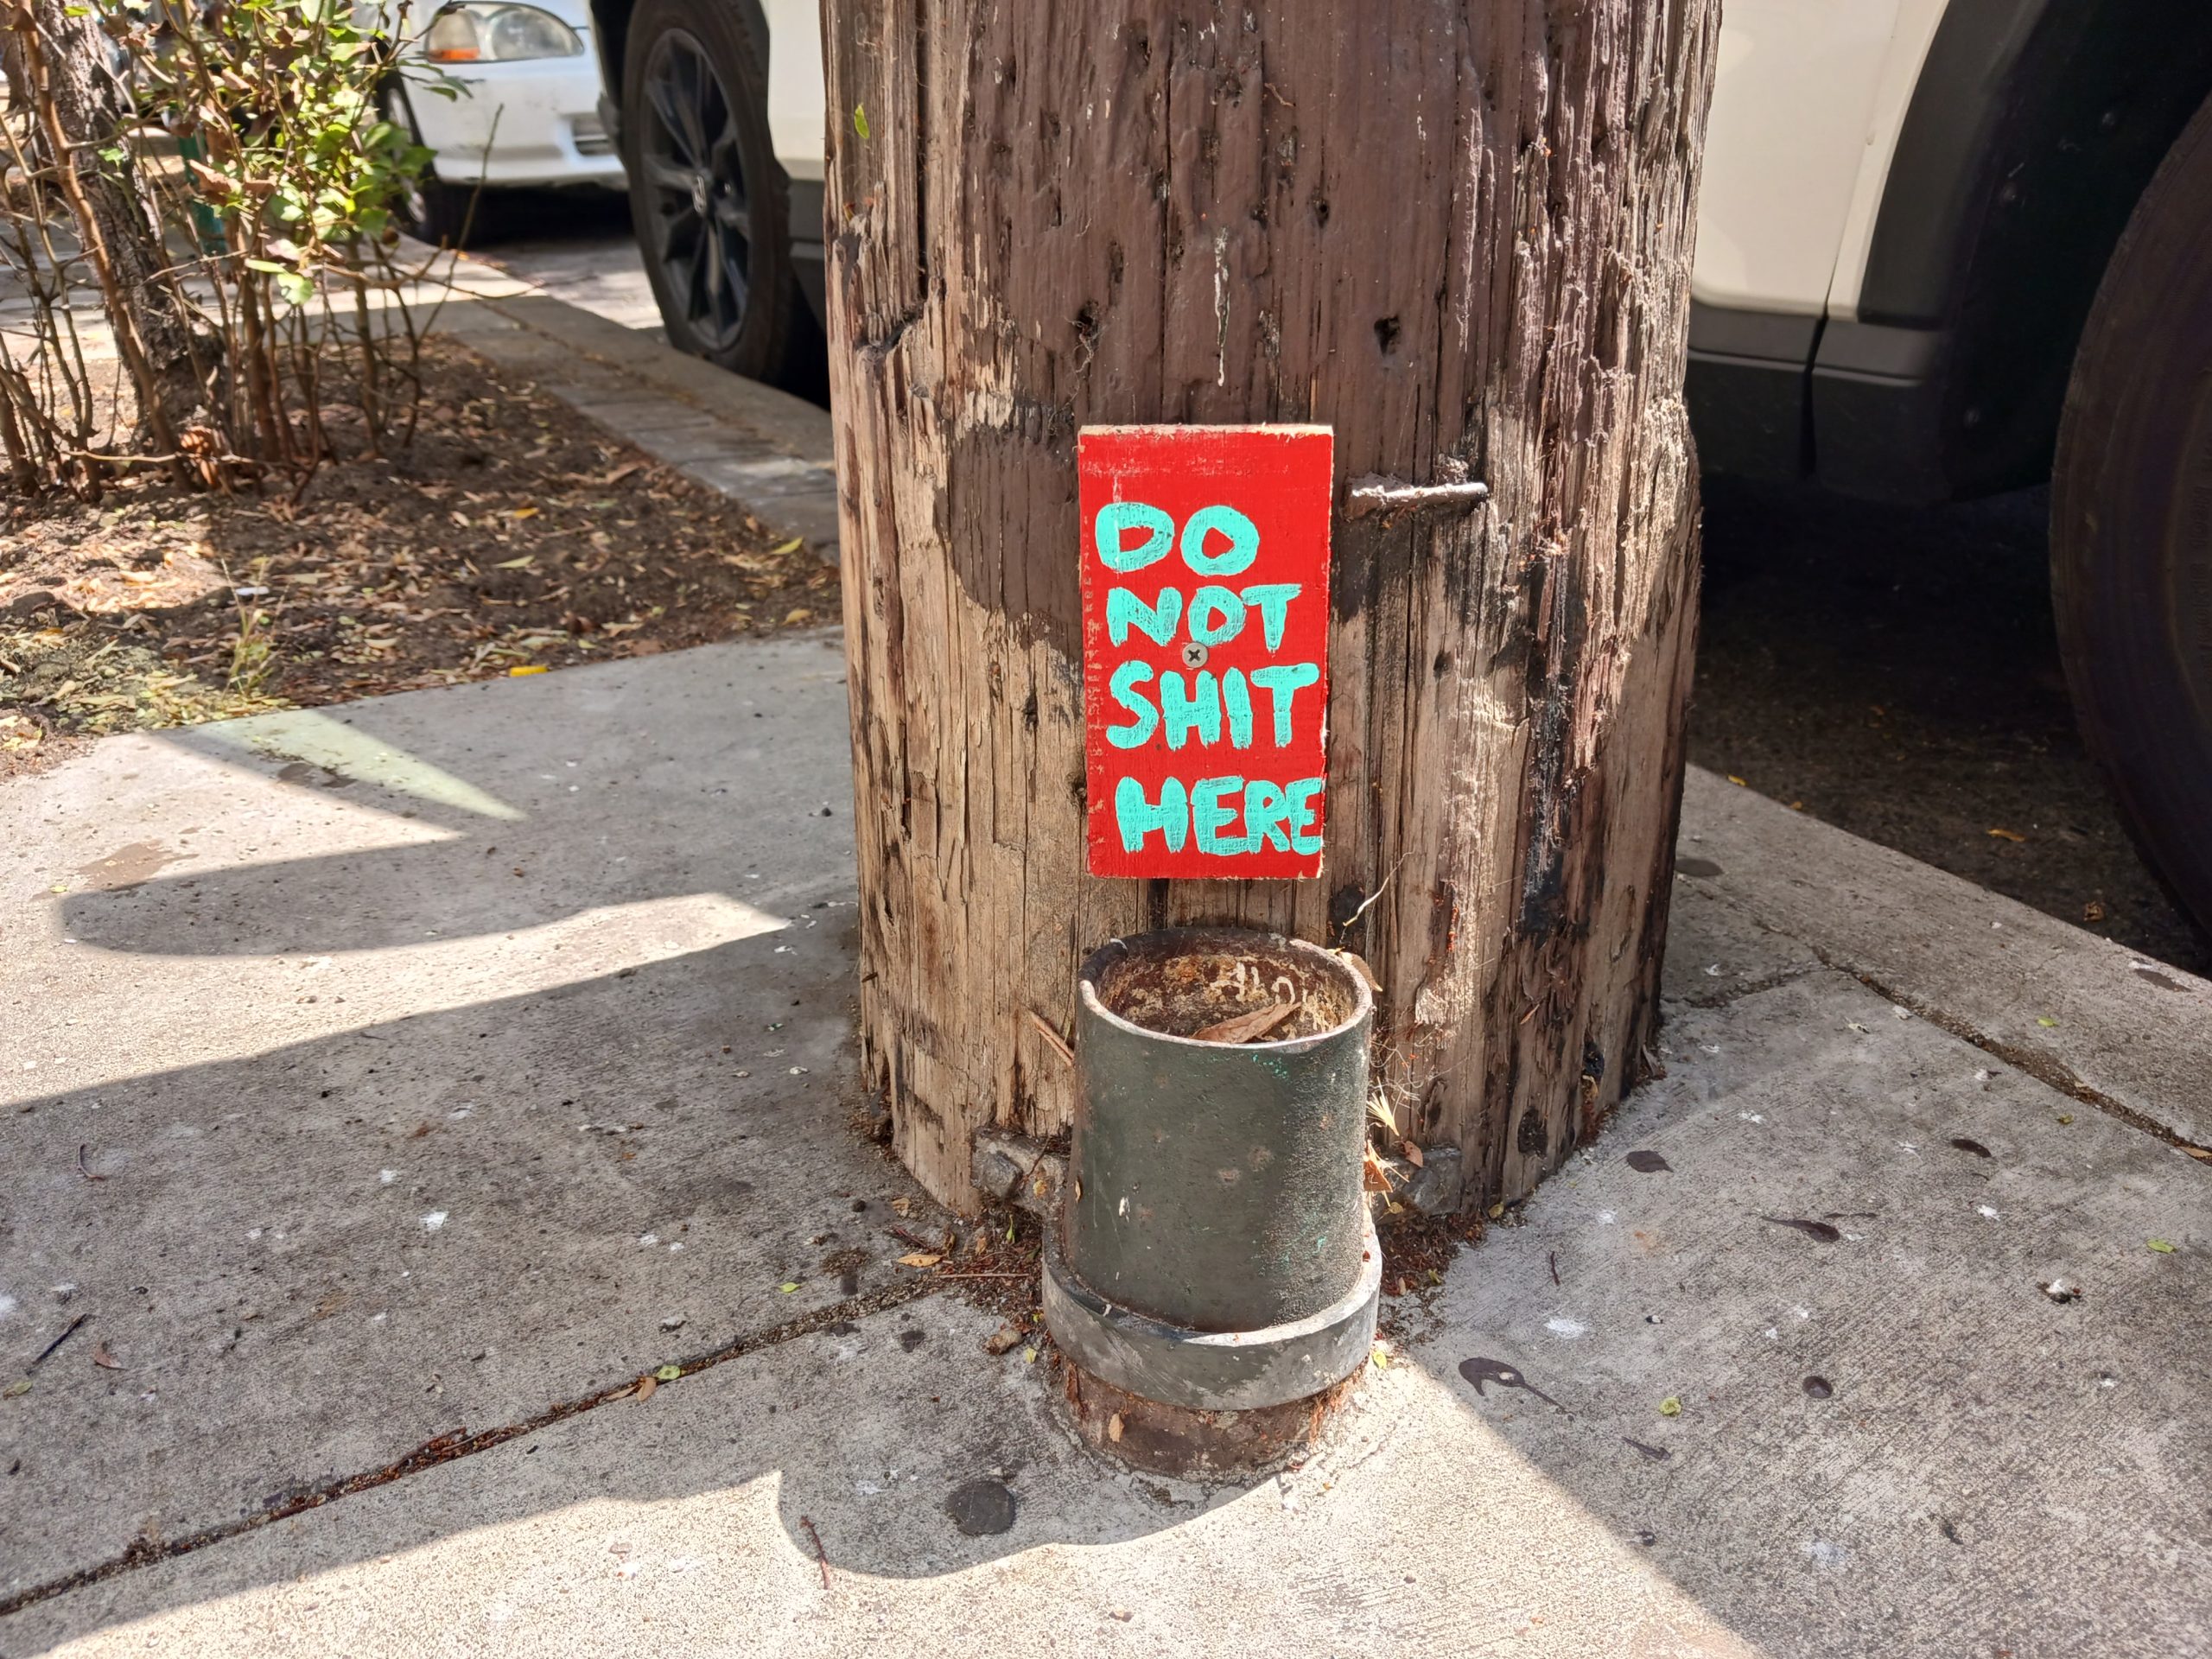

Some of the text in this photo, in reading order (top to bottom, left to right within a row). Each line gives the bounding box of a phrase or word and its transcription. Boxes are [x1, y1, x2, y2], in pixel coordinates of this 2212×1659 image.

[1095, 502, 1260, 575] DO
[1106, 584, 1301, 652] NOT
[1106, 660, 1320, 750] SHIT
[1115, 776, 1323, 855] HERE
